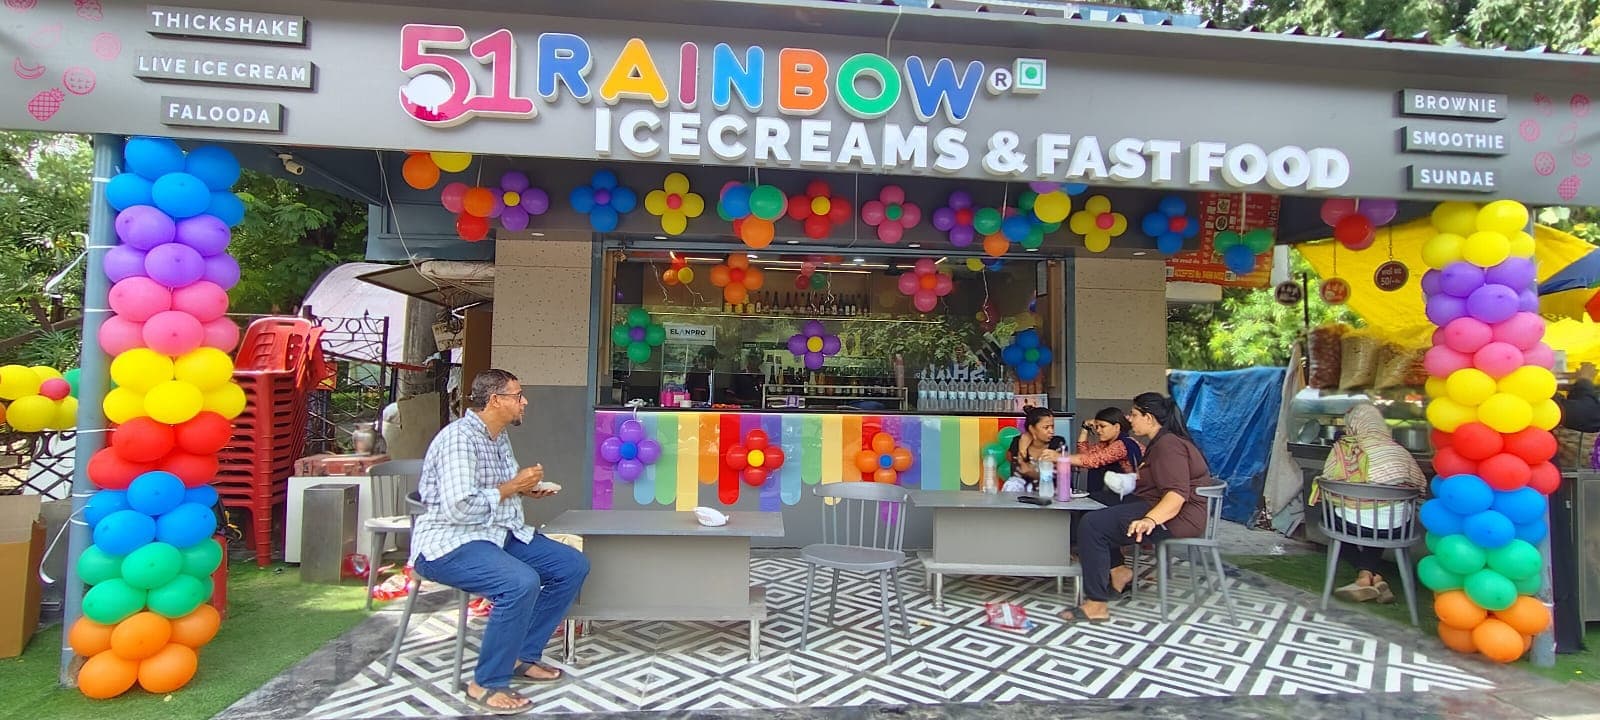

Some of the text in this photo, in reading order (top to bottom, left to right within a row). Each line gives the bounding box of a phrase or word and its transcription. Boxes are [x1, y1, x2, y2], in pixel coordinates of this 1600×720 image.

[151, 11, 299, 37] THICKSHAKE
[138, 56, 305, 82] LIVE ICE CREAM
[399, 23, 985, 126] 51 RAINBOW
[169, 103, 270, 124] FALOODA
[1415, 94, 1497, 113] BROWNIE
[595, 107, 1350, 191] ICECREAMS & FAST FOOD
[1413, 131, 1505, 149] SMOOTHIE
[1420, 168, 1495, 186] SUNDAE
[670, 328, 706, 336] ELANPRO
